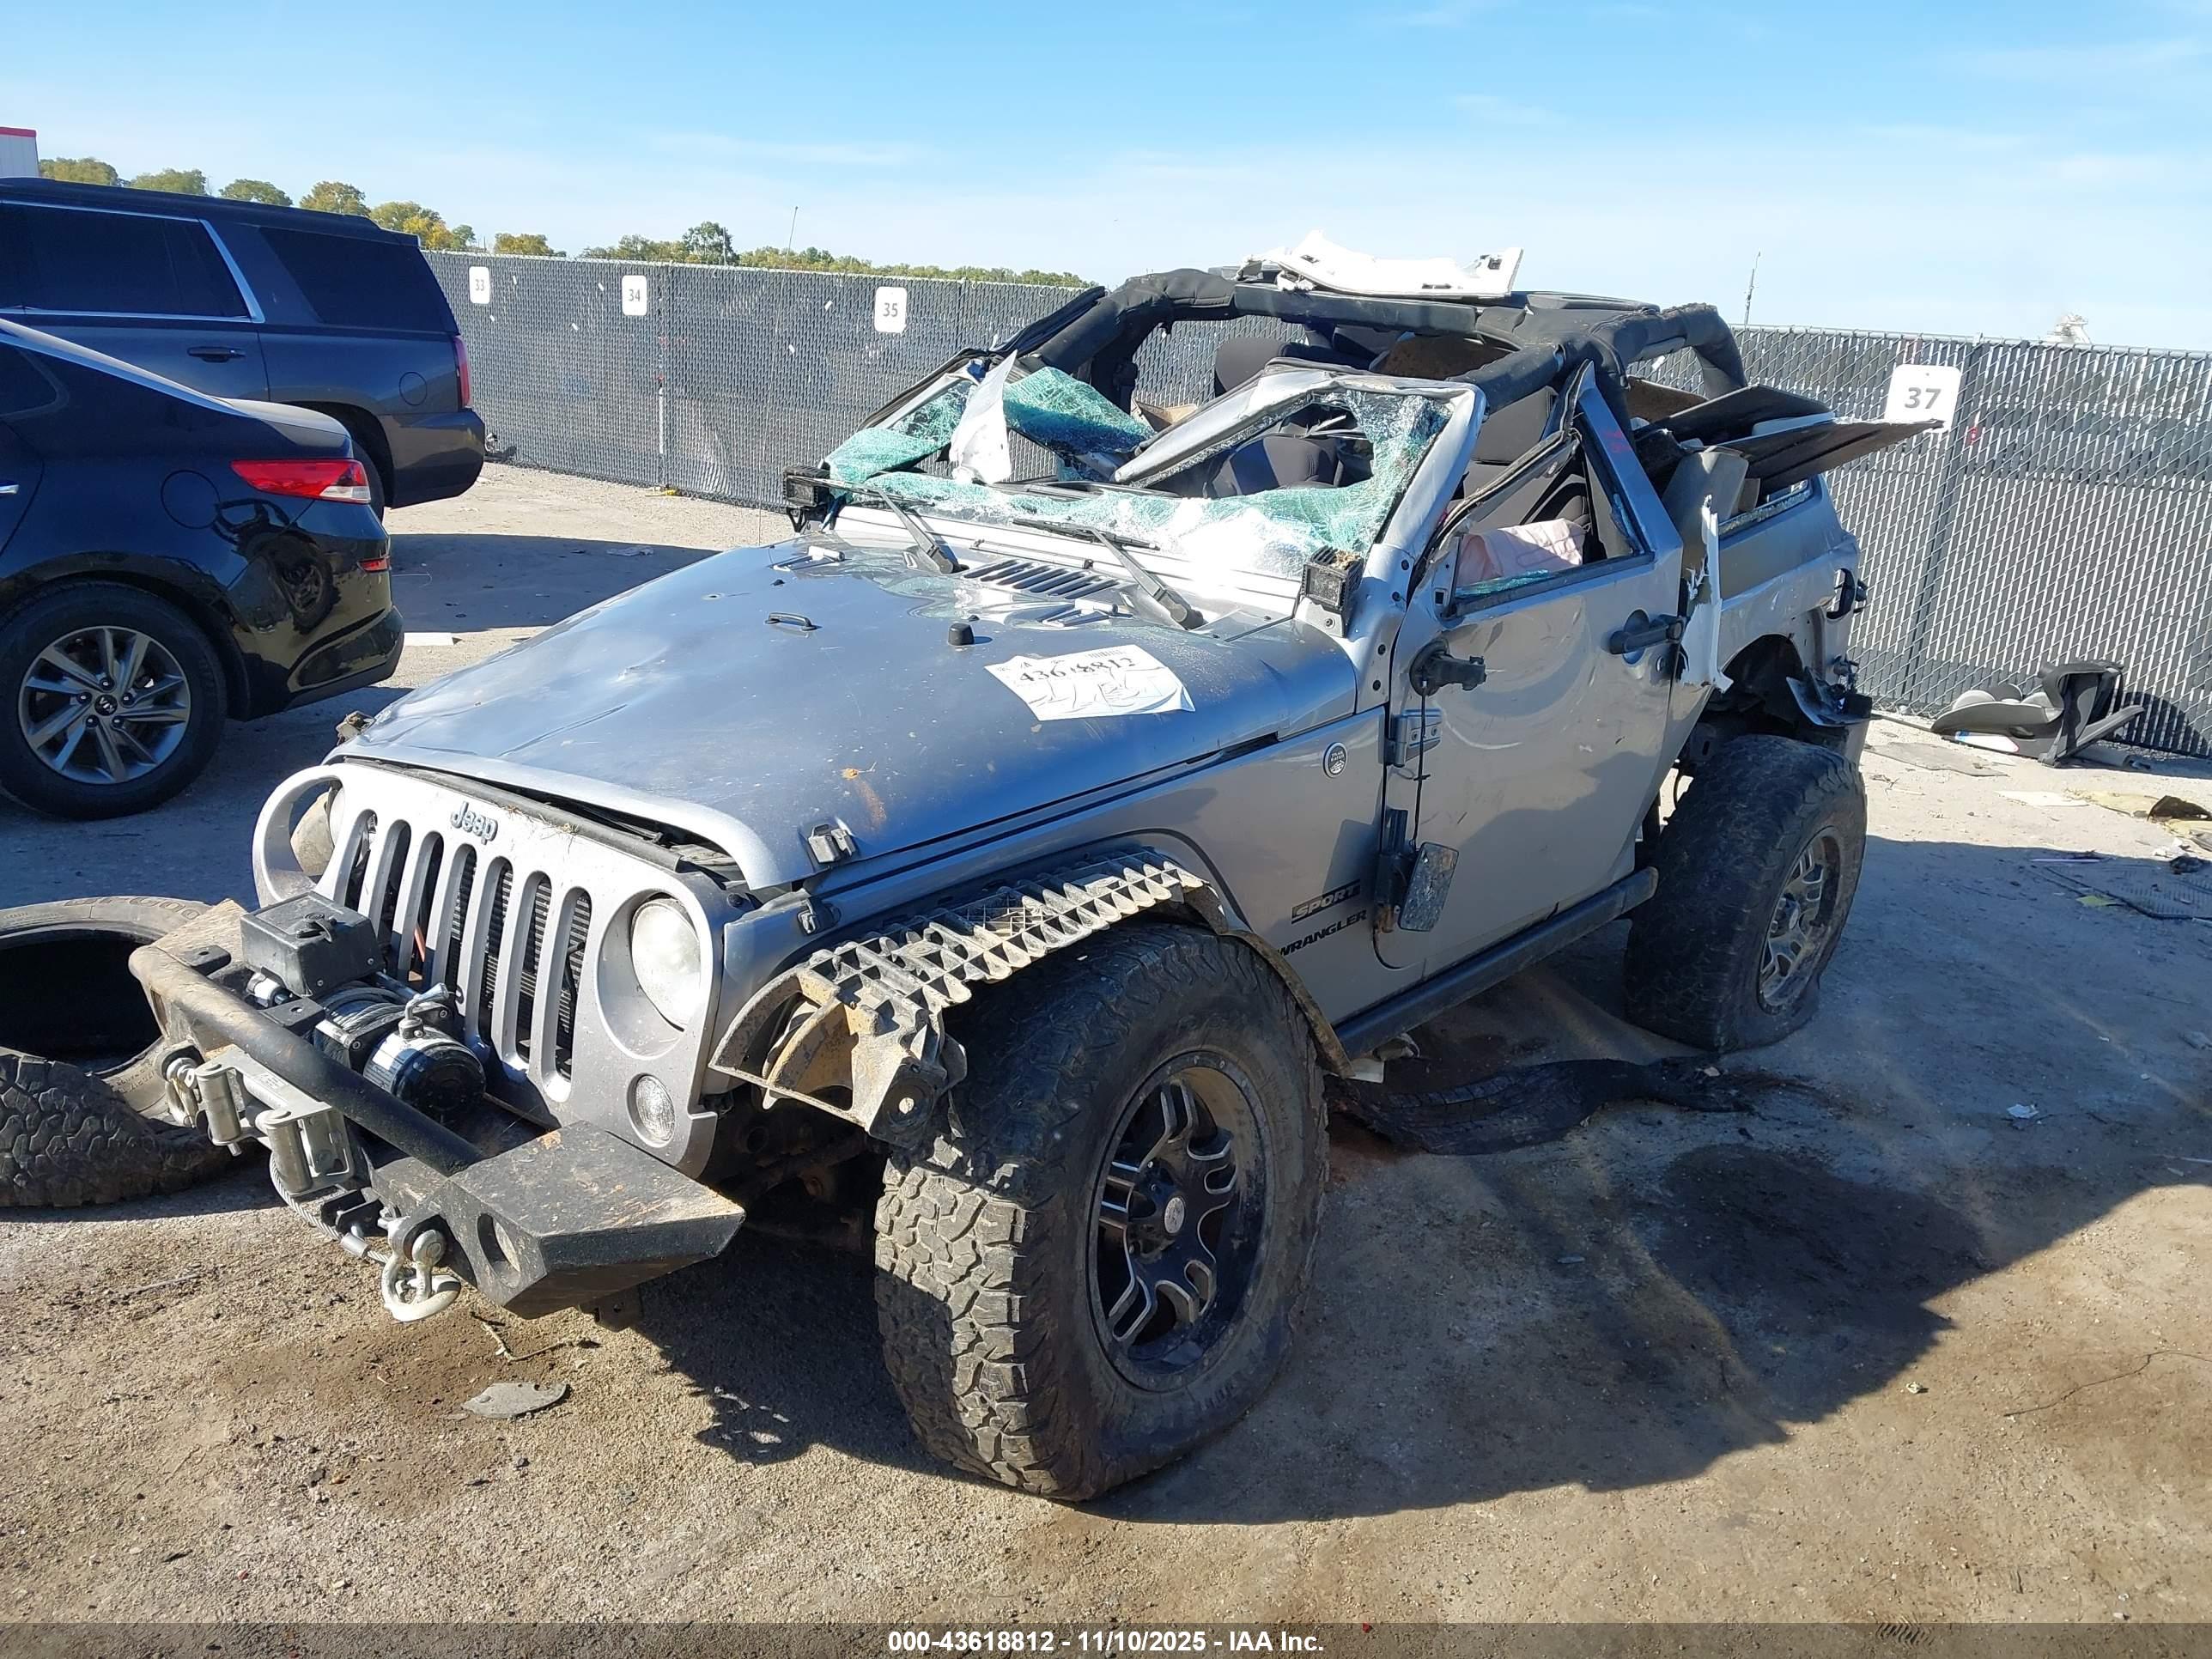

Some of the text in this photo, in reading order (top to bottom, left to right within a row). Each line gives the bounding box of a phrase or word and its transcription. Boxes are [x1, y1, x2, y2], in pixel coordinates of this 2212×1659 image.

[475, 278, 485, 292] 33
[629, 289, 641, 302] 34
[883, 302, 898, 318] 35
[1905, 387, 1942, 410] 37
[450, 801, 498, 846] Jeep
[1295, 884, 1358, 917] SPORT
[1278, 910, 1367, 957] WRANGLER
